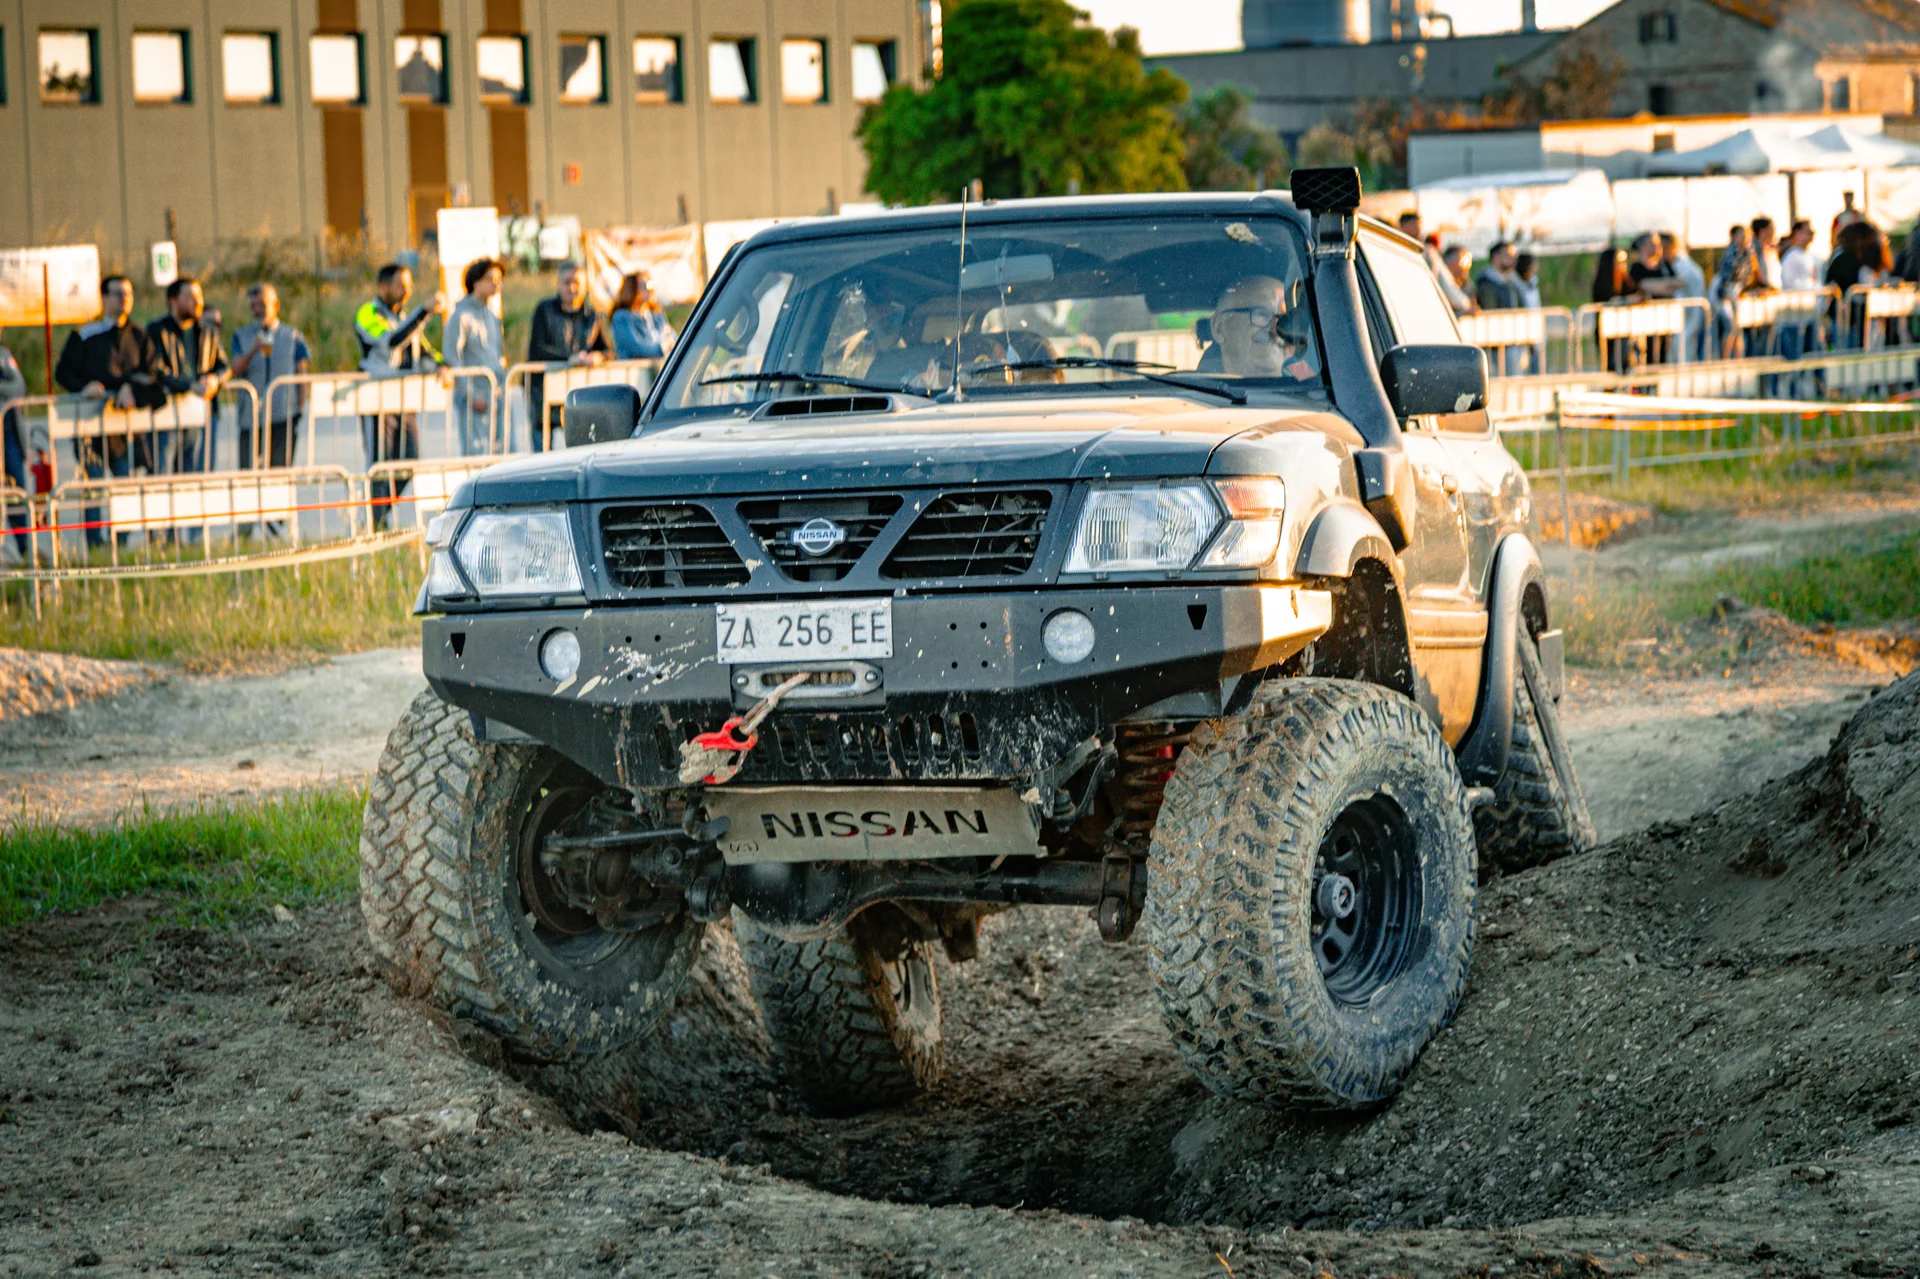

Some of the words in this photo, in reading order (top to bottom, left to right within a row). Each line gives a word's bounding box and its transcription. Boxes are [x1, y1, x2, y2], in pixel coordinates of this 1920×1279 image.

[798, 531, 838, 540] NISSAN
[720, 617, 756, 649] ZA
[777, 614, 833, 646] 256
[851, 611, 888, 644] EE
[760, 810, 989, 838] NISSAN
